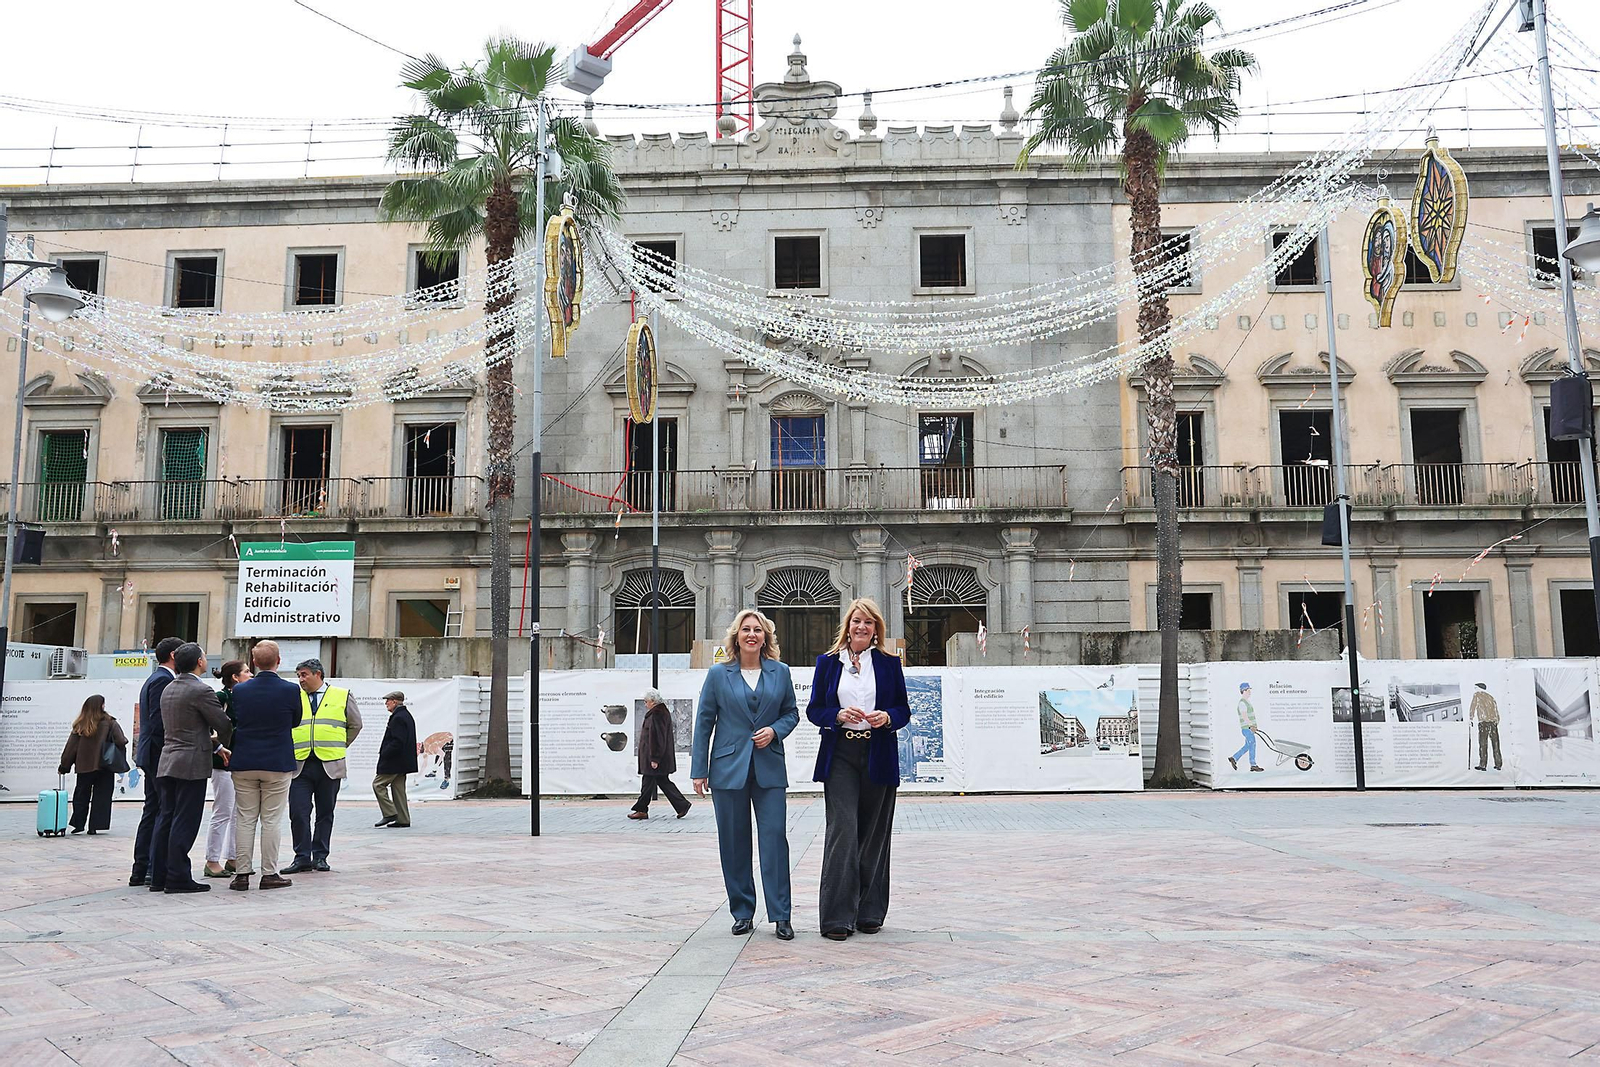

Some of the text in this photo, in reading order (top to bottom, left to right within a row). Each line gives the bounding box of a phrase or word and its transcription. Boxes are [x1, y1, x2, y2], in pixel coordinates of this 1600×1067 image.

[246, 566, 326, 578] Terminación
[245, 581, 337, 593] Rehabilitación
[244, 597, 291, 608] Edificio
[243, 612, 341, 623] Administrativo
[6, 649, 25, 659] PICOTE
